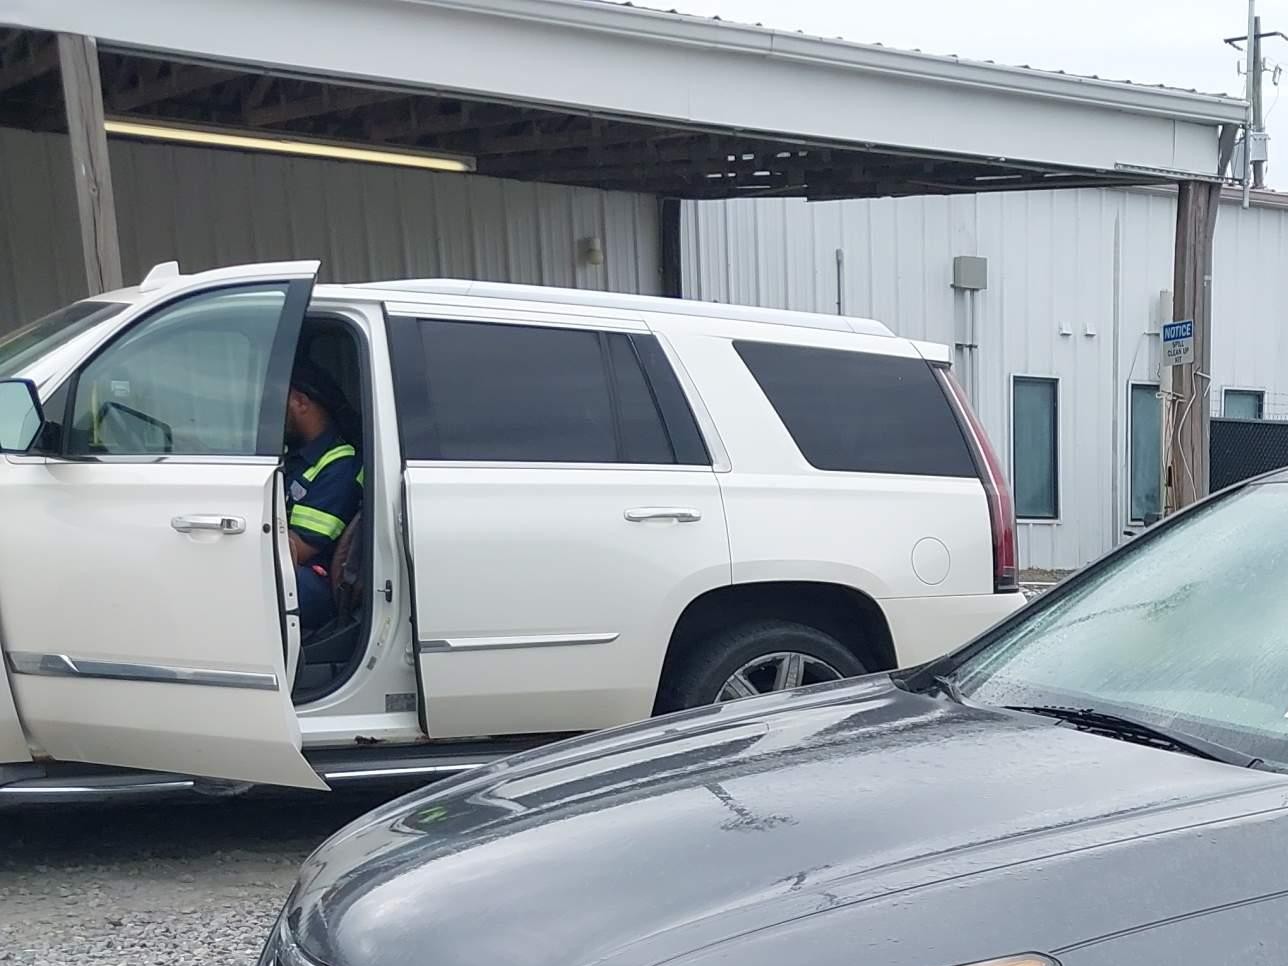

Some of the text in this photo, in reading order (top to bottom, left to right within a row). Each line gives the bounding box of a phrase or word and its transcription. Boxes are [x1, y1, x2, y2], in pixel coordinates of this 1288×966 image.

[1165, 323, 1191, 339] NOTICE
[1168, 346, 1189, 357] CLEAN UP
